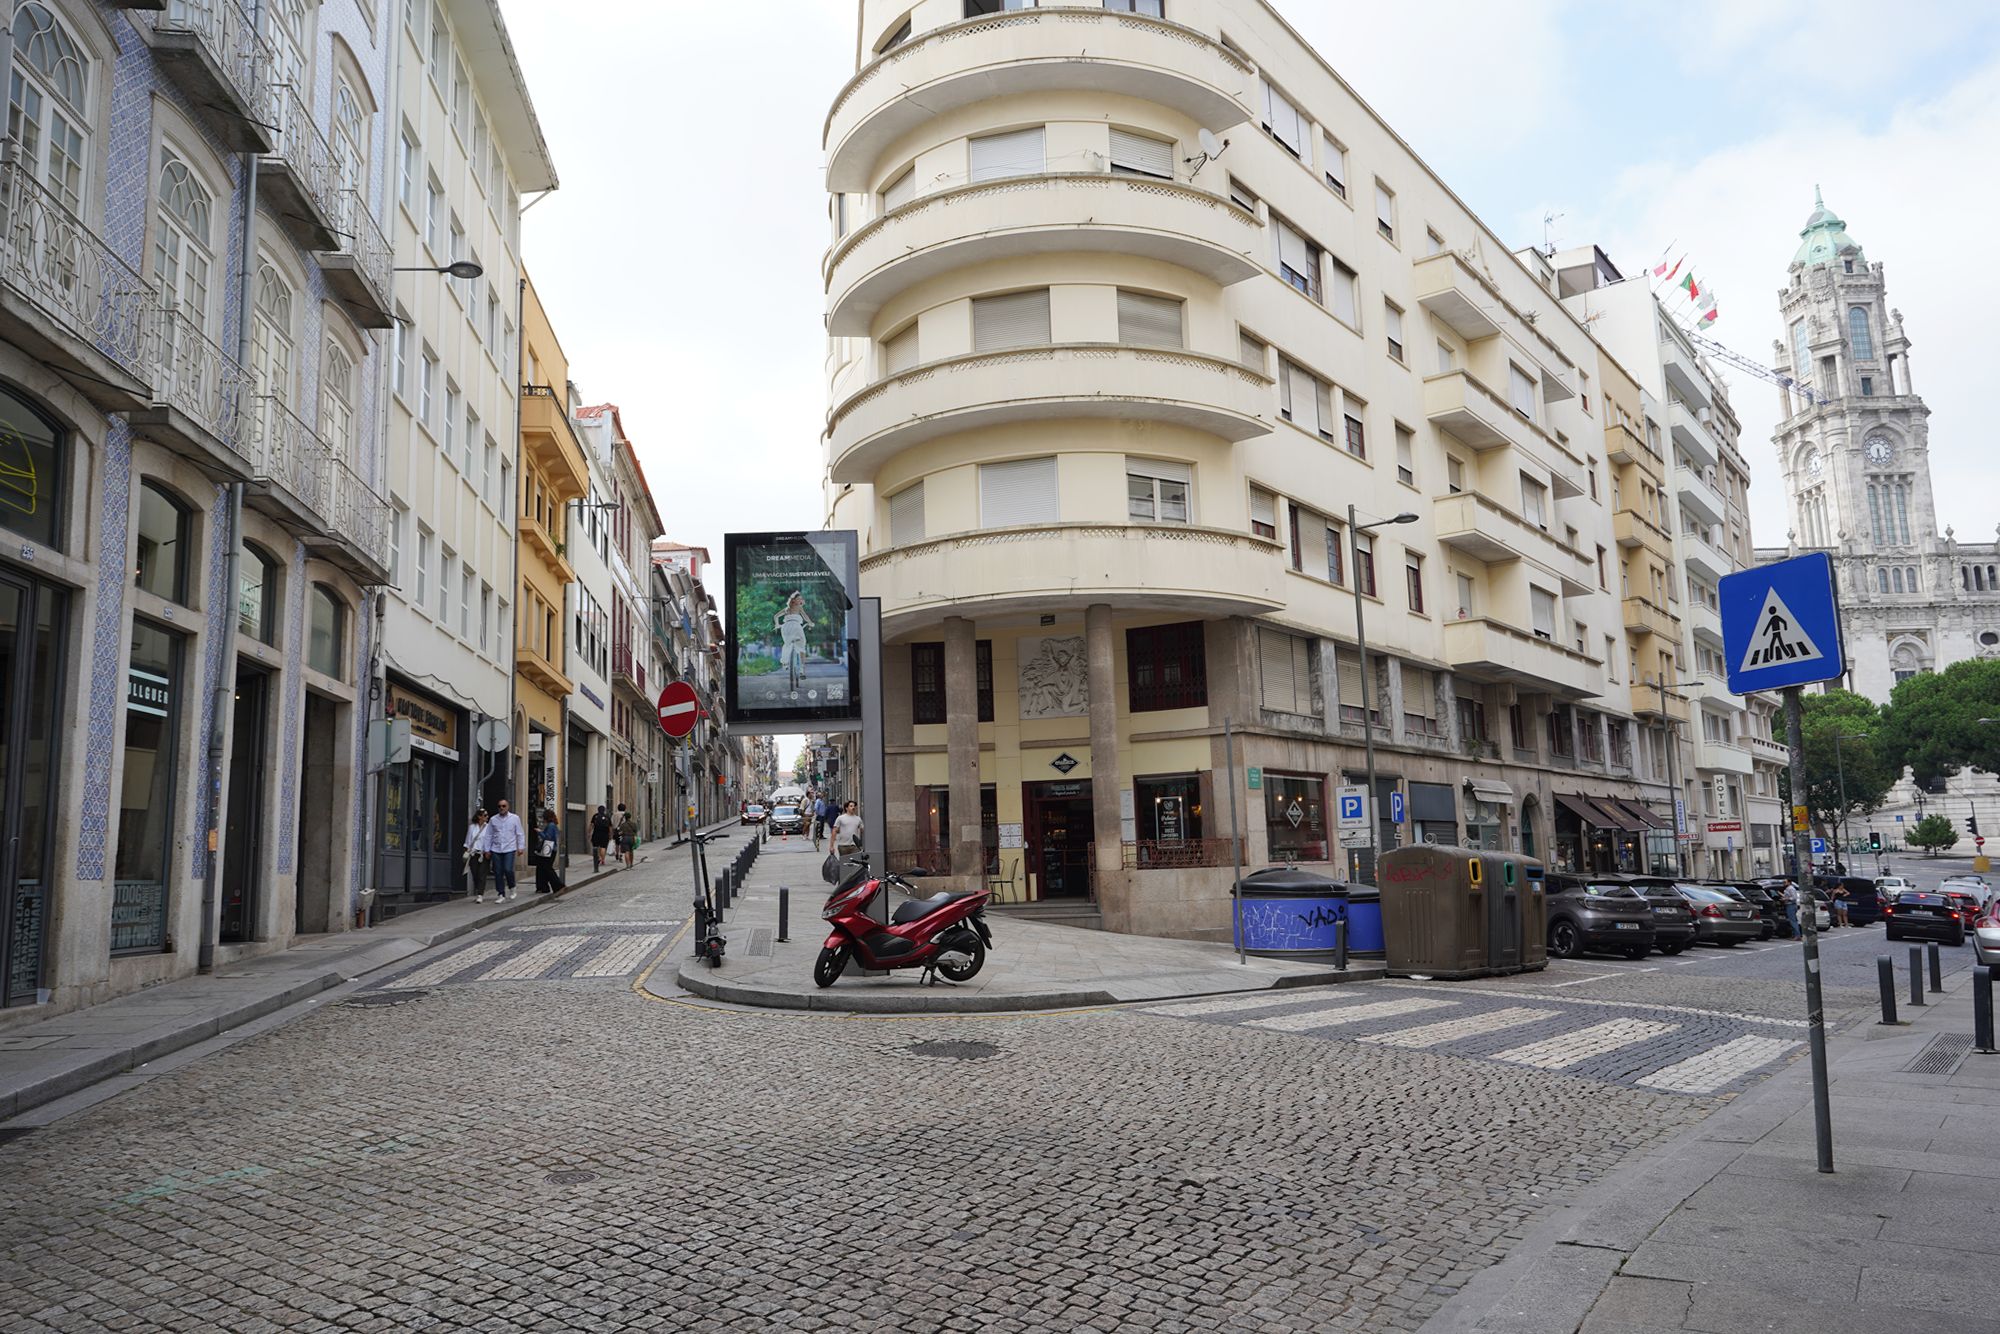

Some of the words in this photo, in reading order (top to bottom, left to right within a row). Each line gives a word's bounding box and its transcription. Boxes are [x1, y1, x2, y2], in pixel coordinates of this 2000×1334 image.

[1345, 799, 1358, 817] P
[1394, 795, 1402, 820] P
[1716, 778, 1726, 815] HOTEL
[1811, 840, 1821, 852] P
[27, 898, 41, 980] FISHERMAN
